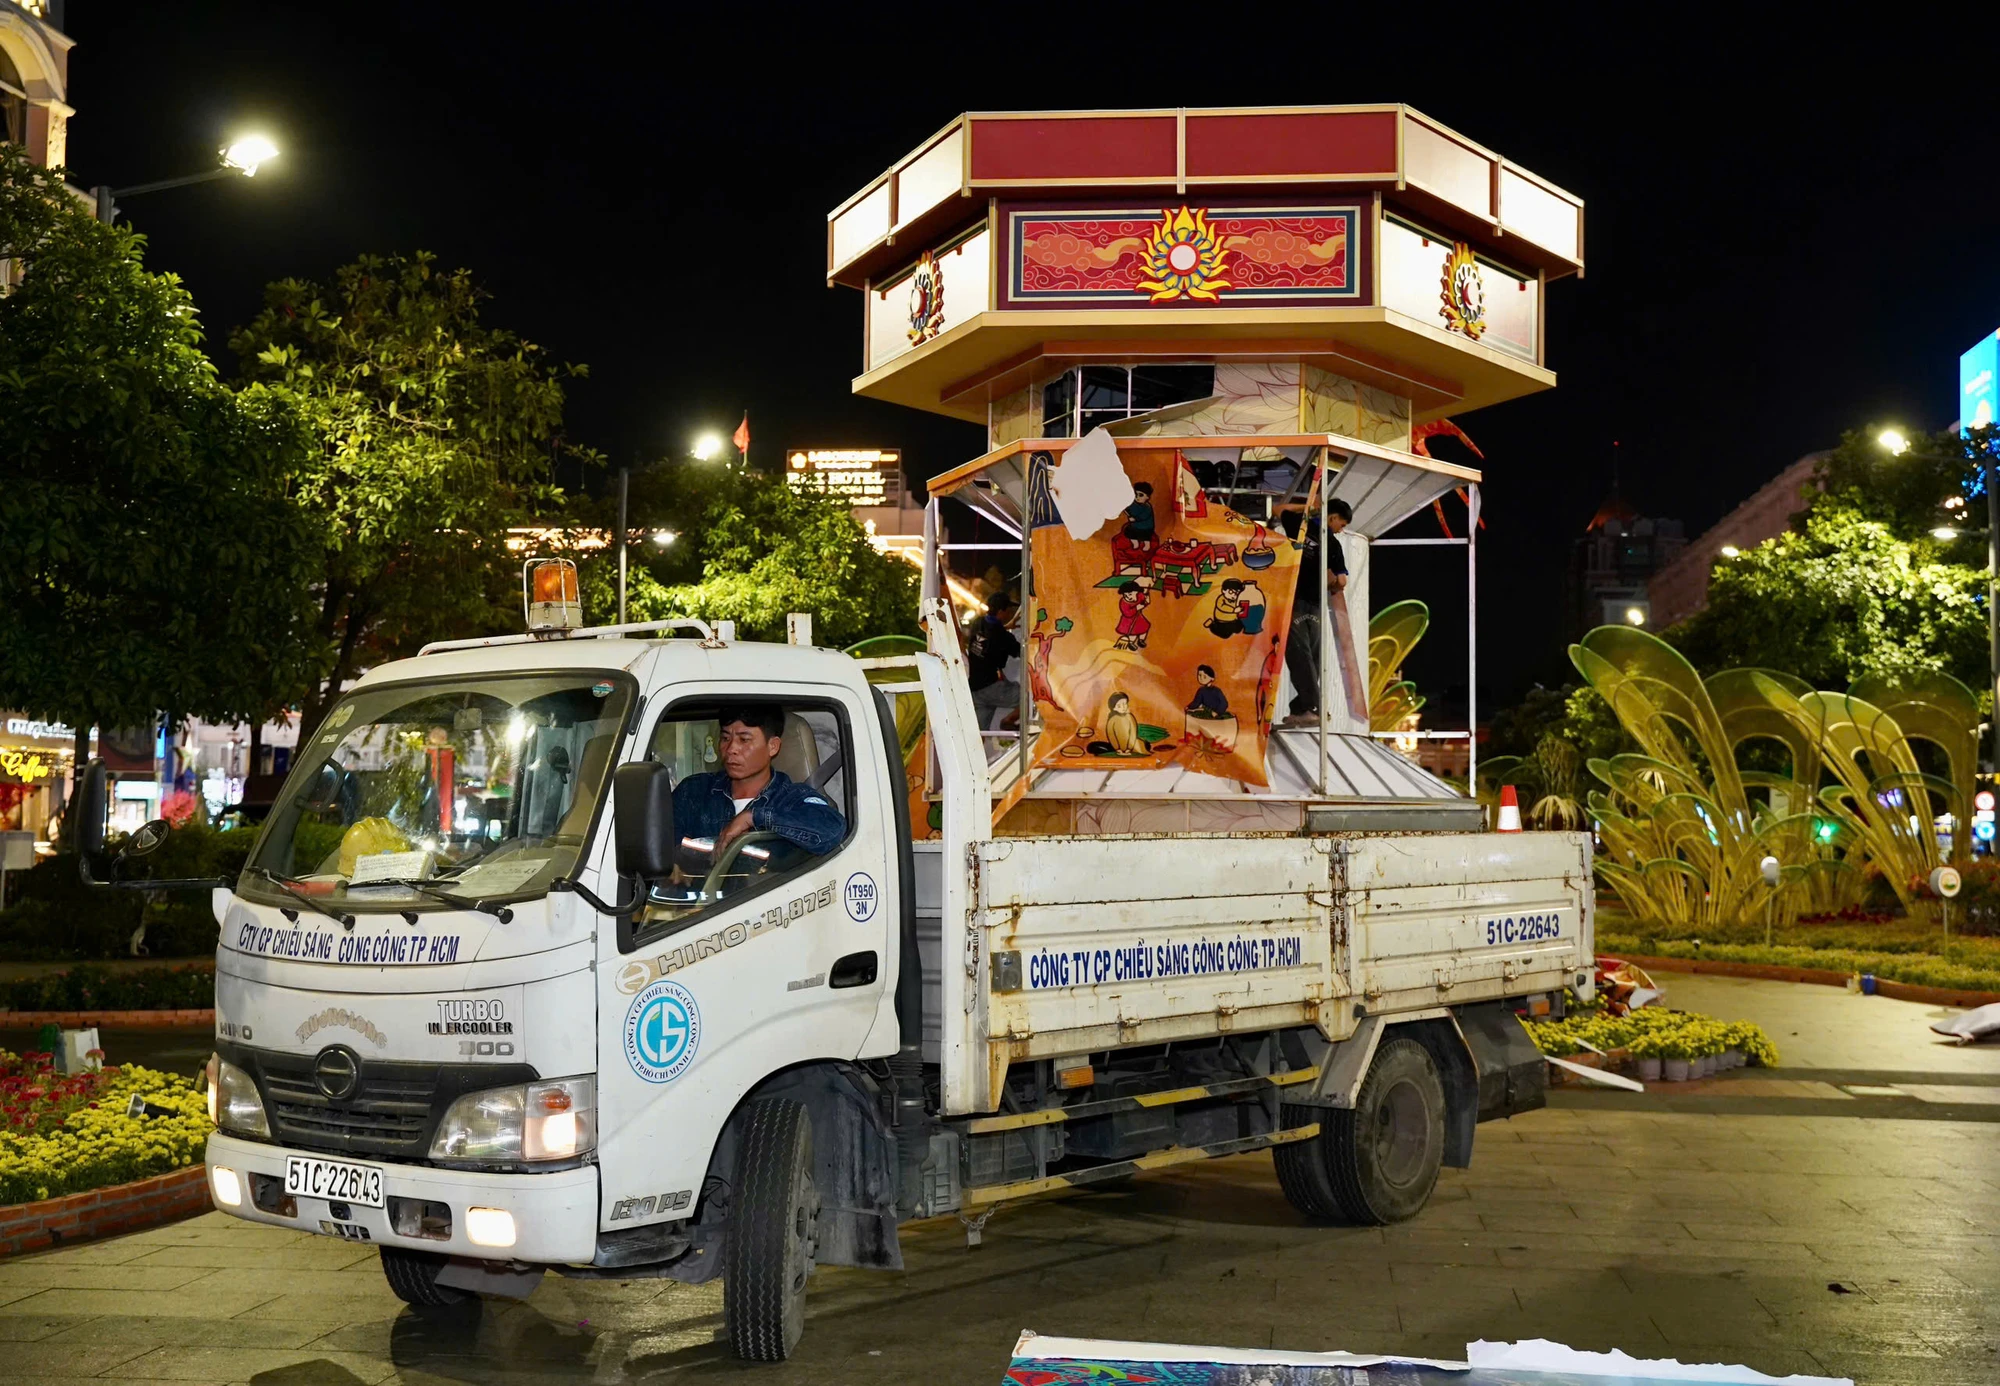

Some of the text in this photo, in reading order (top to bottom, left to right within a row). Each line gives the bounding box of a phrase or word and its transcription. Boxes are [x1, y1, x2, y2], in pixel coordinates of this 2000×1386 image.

[827, 472, 886, 484] HOTEL
[848, 884, 874, 898] 1T950
[856, 901, 867, 915] 3N
[239, 921, 460, 963] CTY CP CHIẾU SÁNG CÔNG CÔNG TP HCM
[1487, 914, 1559, 945] 51C-22643
[657, 923, 747, 975] HINO
[1030, 947, 1069, 989] CÔNG
[1073, 951, 1090, 984] TY
[1094, 949, 1111, 983] CP
[1157, 938, 1189, 977] SÁNG
[1192, 936, 1224, 974] CÔNG
[1227, 934, 1259, 971] CÔNG
[1261, 936, 1301, 968] TP.HCM
[427, 1021, 514, 1036] INTERCOOLER
[437, 999, 504, 1033] TURBO
[609, 1195, 657, 1221] 130
